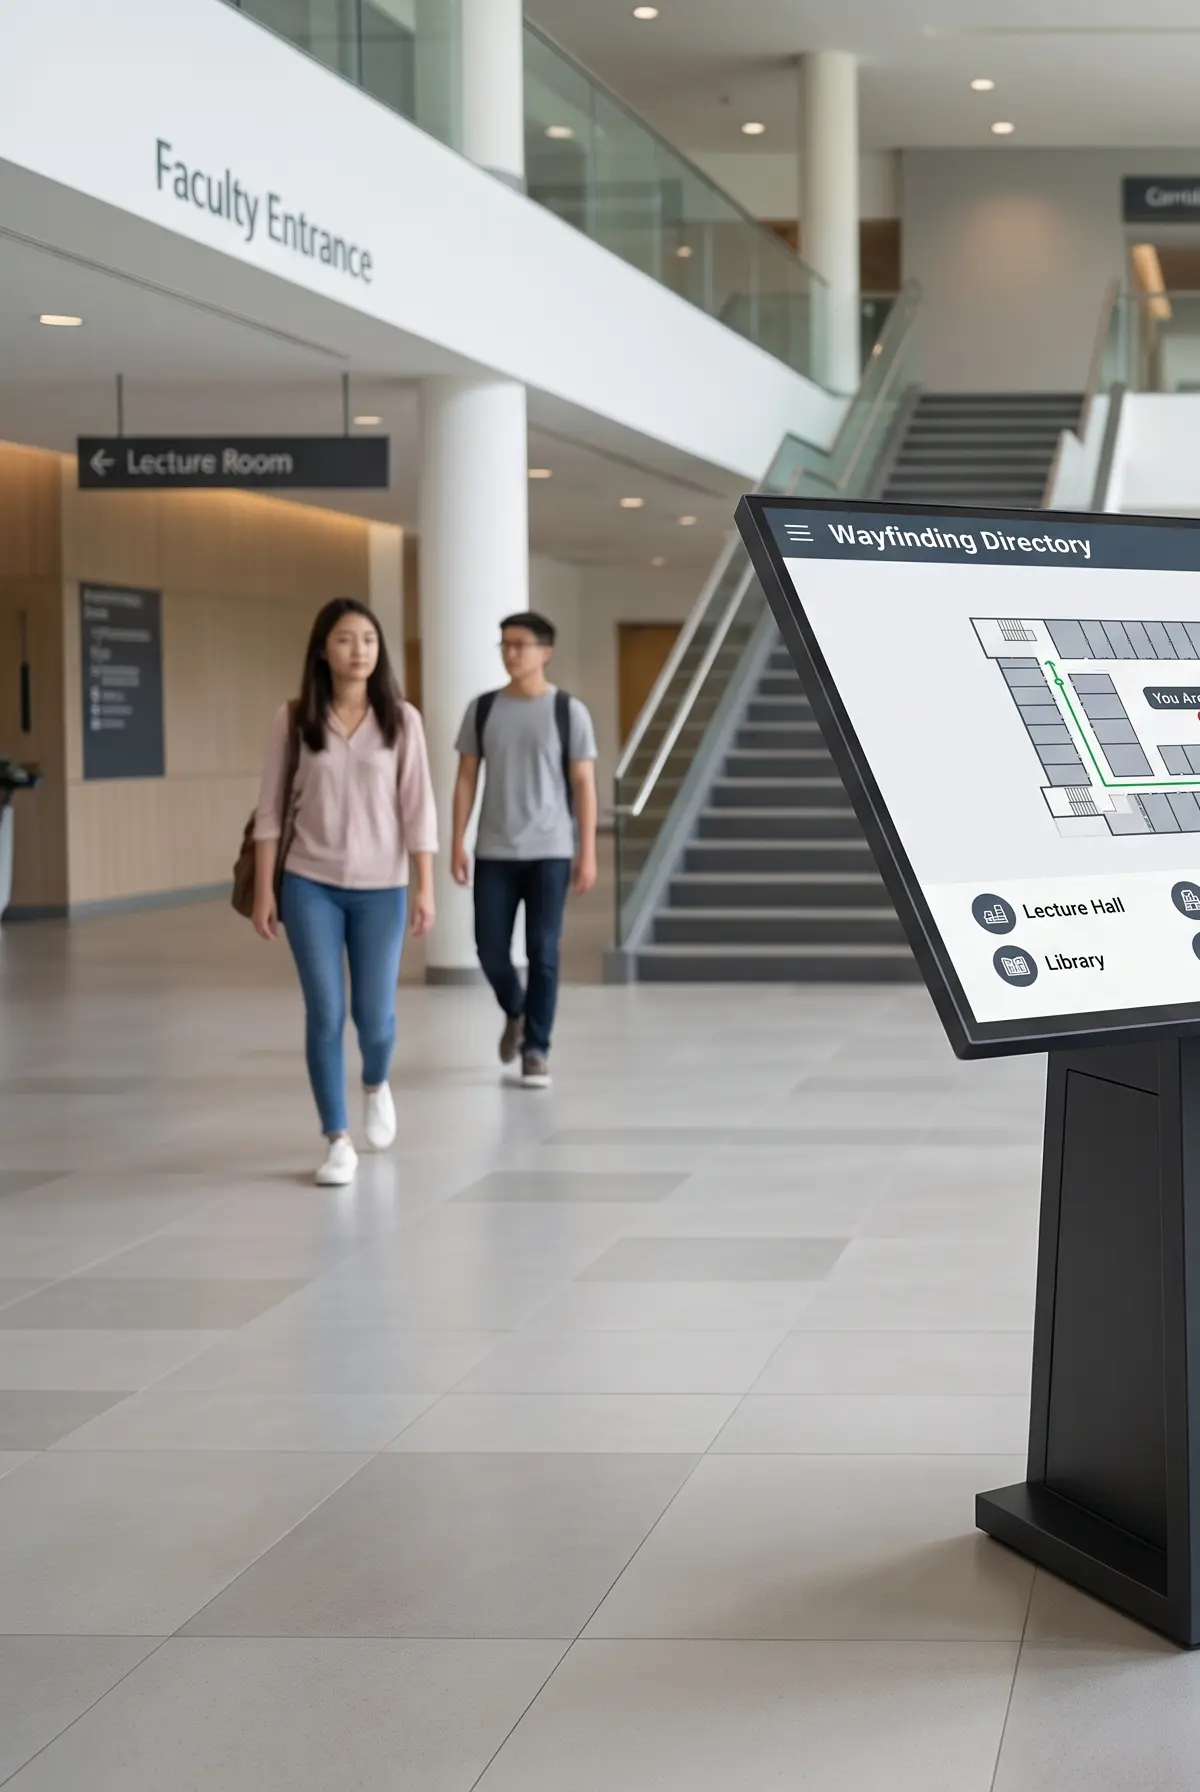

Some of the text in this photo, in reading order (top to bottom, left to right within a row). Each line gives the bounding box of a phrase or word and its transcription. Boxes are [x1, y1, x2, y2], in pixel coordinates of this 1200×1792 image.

[156, 137, 373, 284] Faculty Entrance
[127, 448, 293, 475] Lecture Room
[828, 523, 1092, 560] Wayfinding Directory
[1152, 692, 1180, 704] You
[1022, 896, 1126, 920] Lecture Hall
[1044, 952, 1106, 972] Library
